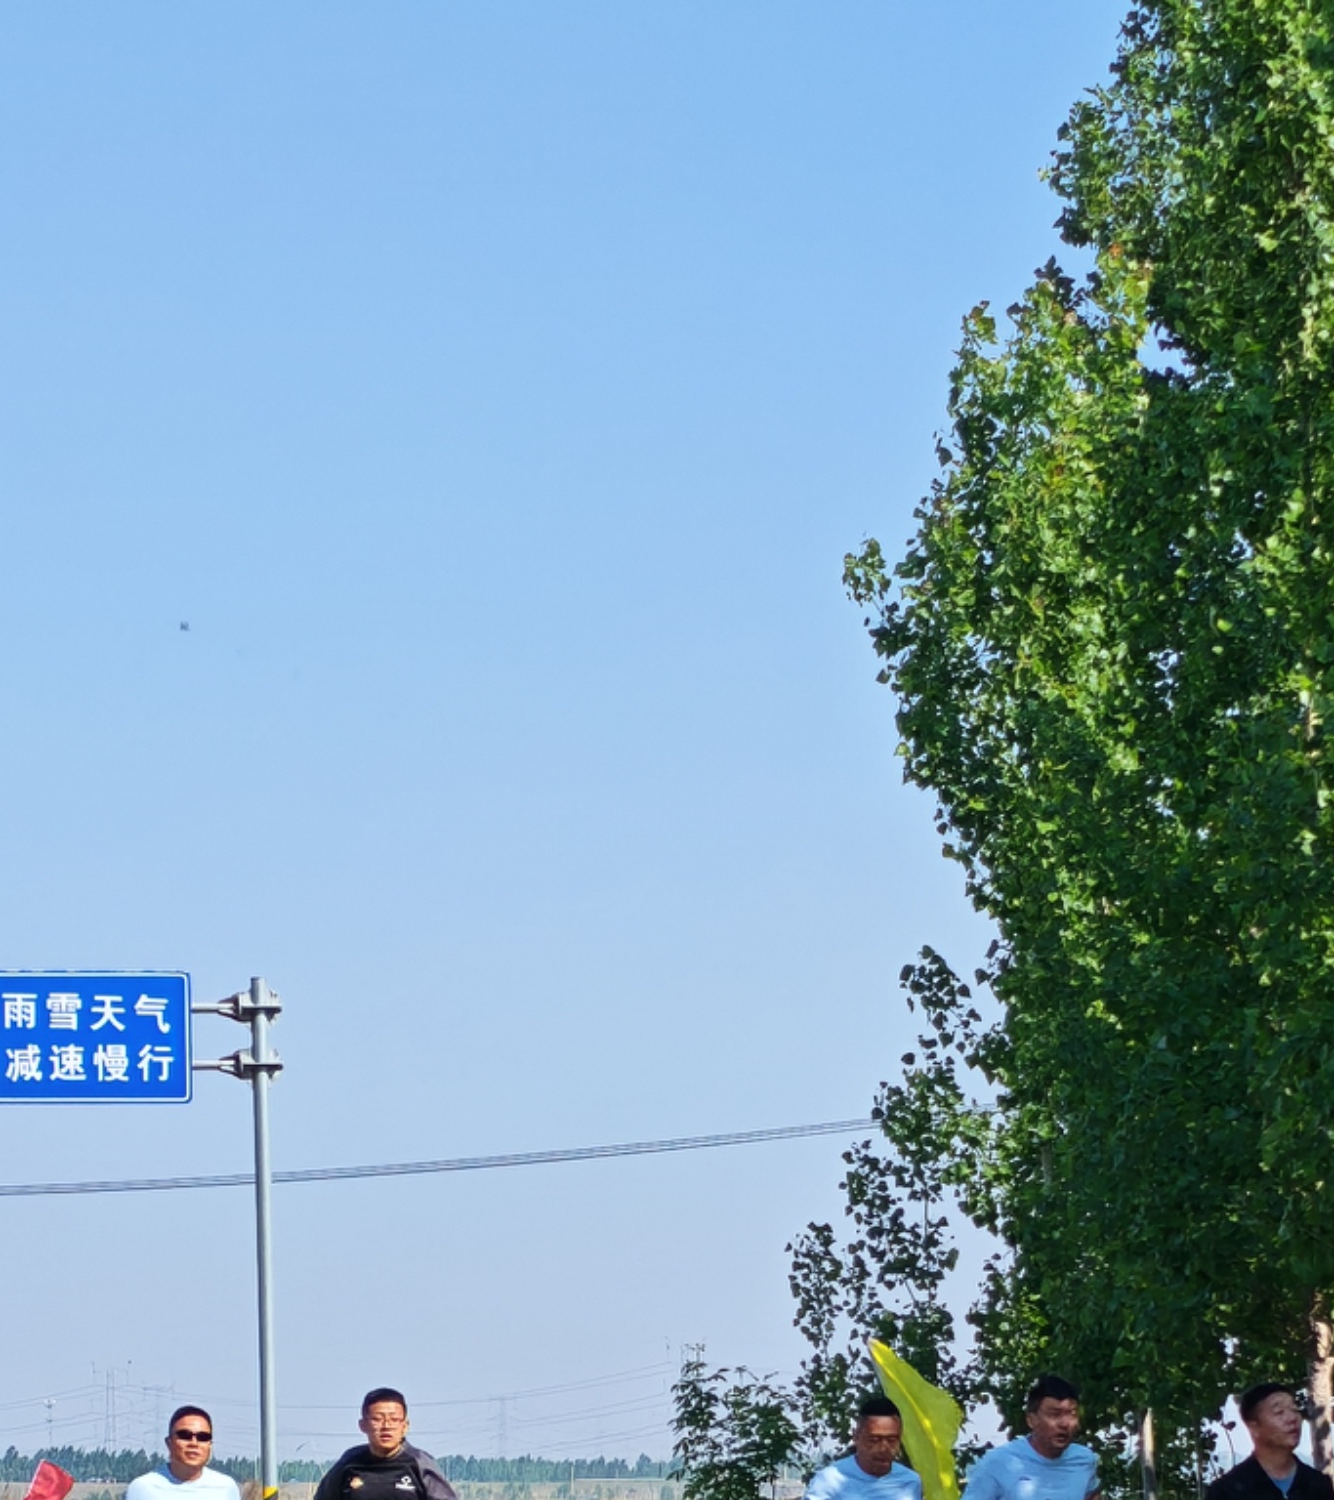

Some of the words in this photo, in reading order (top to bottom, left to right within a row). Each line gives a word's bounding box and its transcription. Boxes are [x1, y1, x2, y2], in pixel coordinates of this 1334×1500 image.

[1, 992, 171, 1034] 雨雪天气
[5, 1044, 174, 1082] 减速慢行
